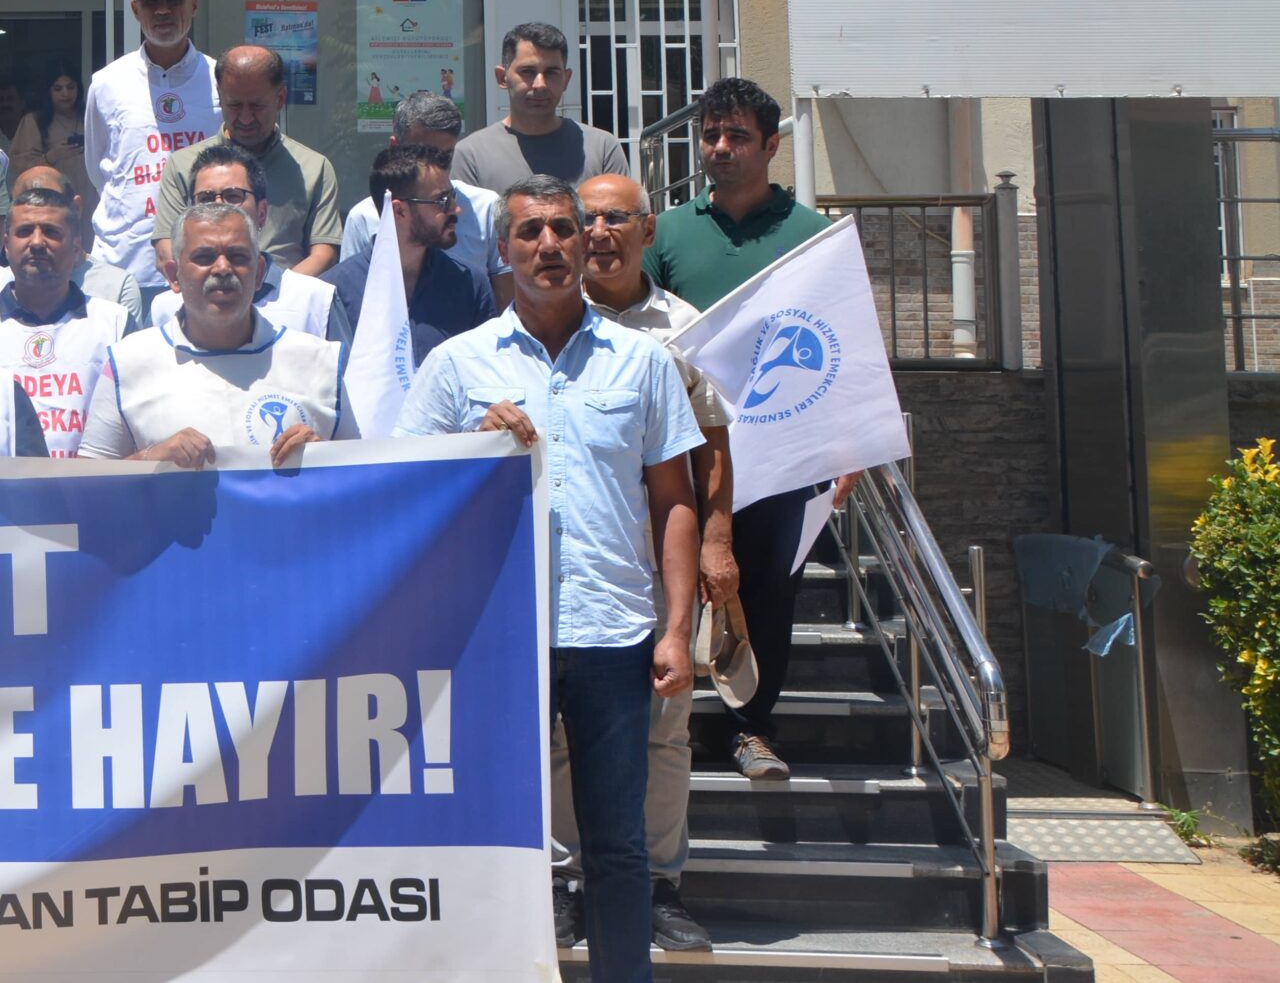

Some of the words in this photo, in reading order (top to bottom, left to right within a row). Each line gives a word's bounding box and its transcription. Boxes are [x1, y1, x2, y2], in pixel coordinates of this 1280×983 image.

[760, 321, 770, 336] VE
[770, 308, 814, 323] SOSYAL
[813, 319, 841, 354] HİZMET
[794, 357, 841, 415] EMEKÇİLERİ
[737, 409, 793, 424] SENDİKAS
[69, 669, 455, 809] HAYIR!
[85, 866, 249, 928] TABİP
[261, 877, 440, 923] ODASI
